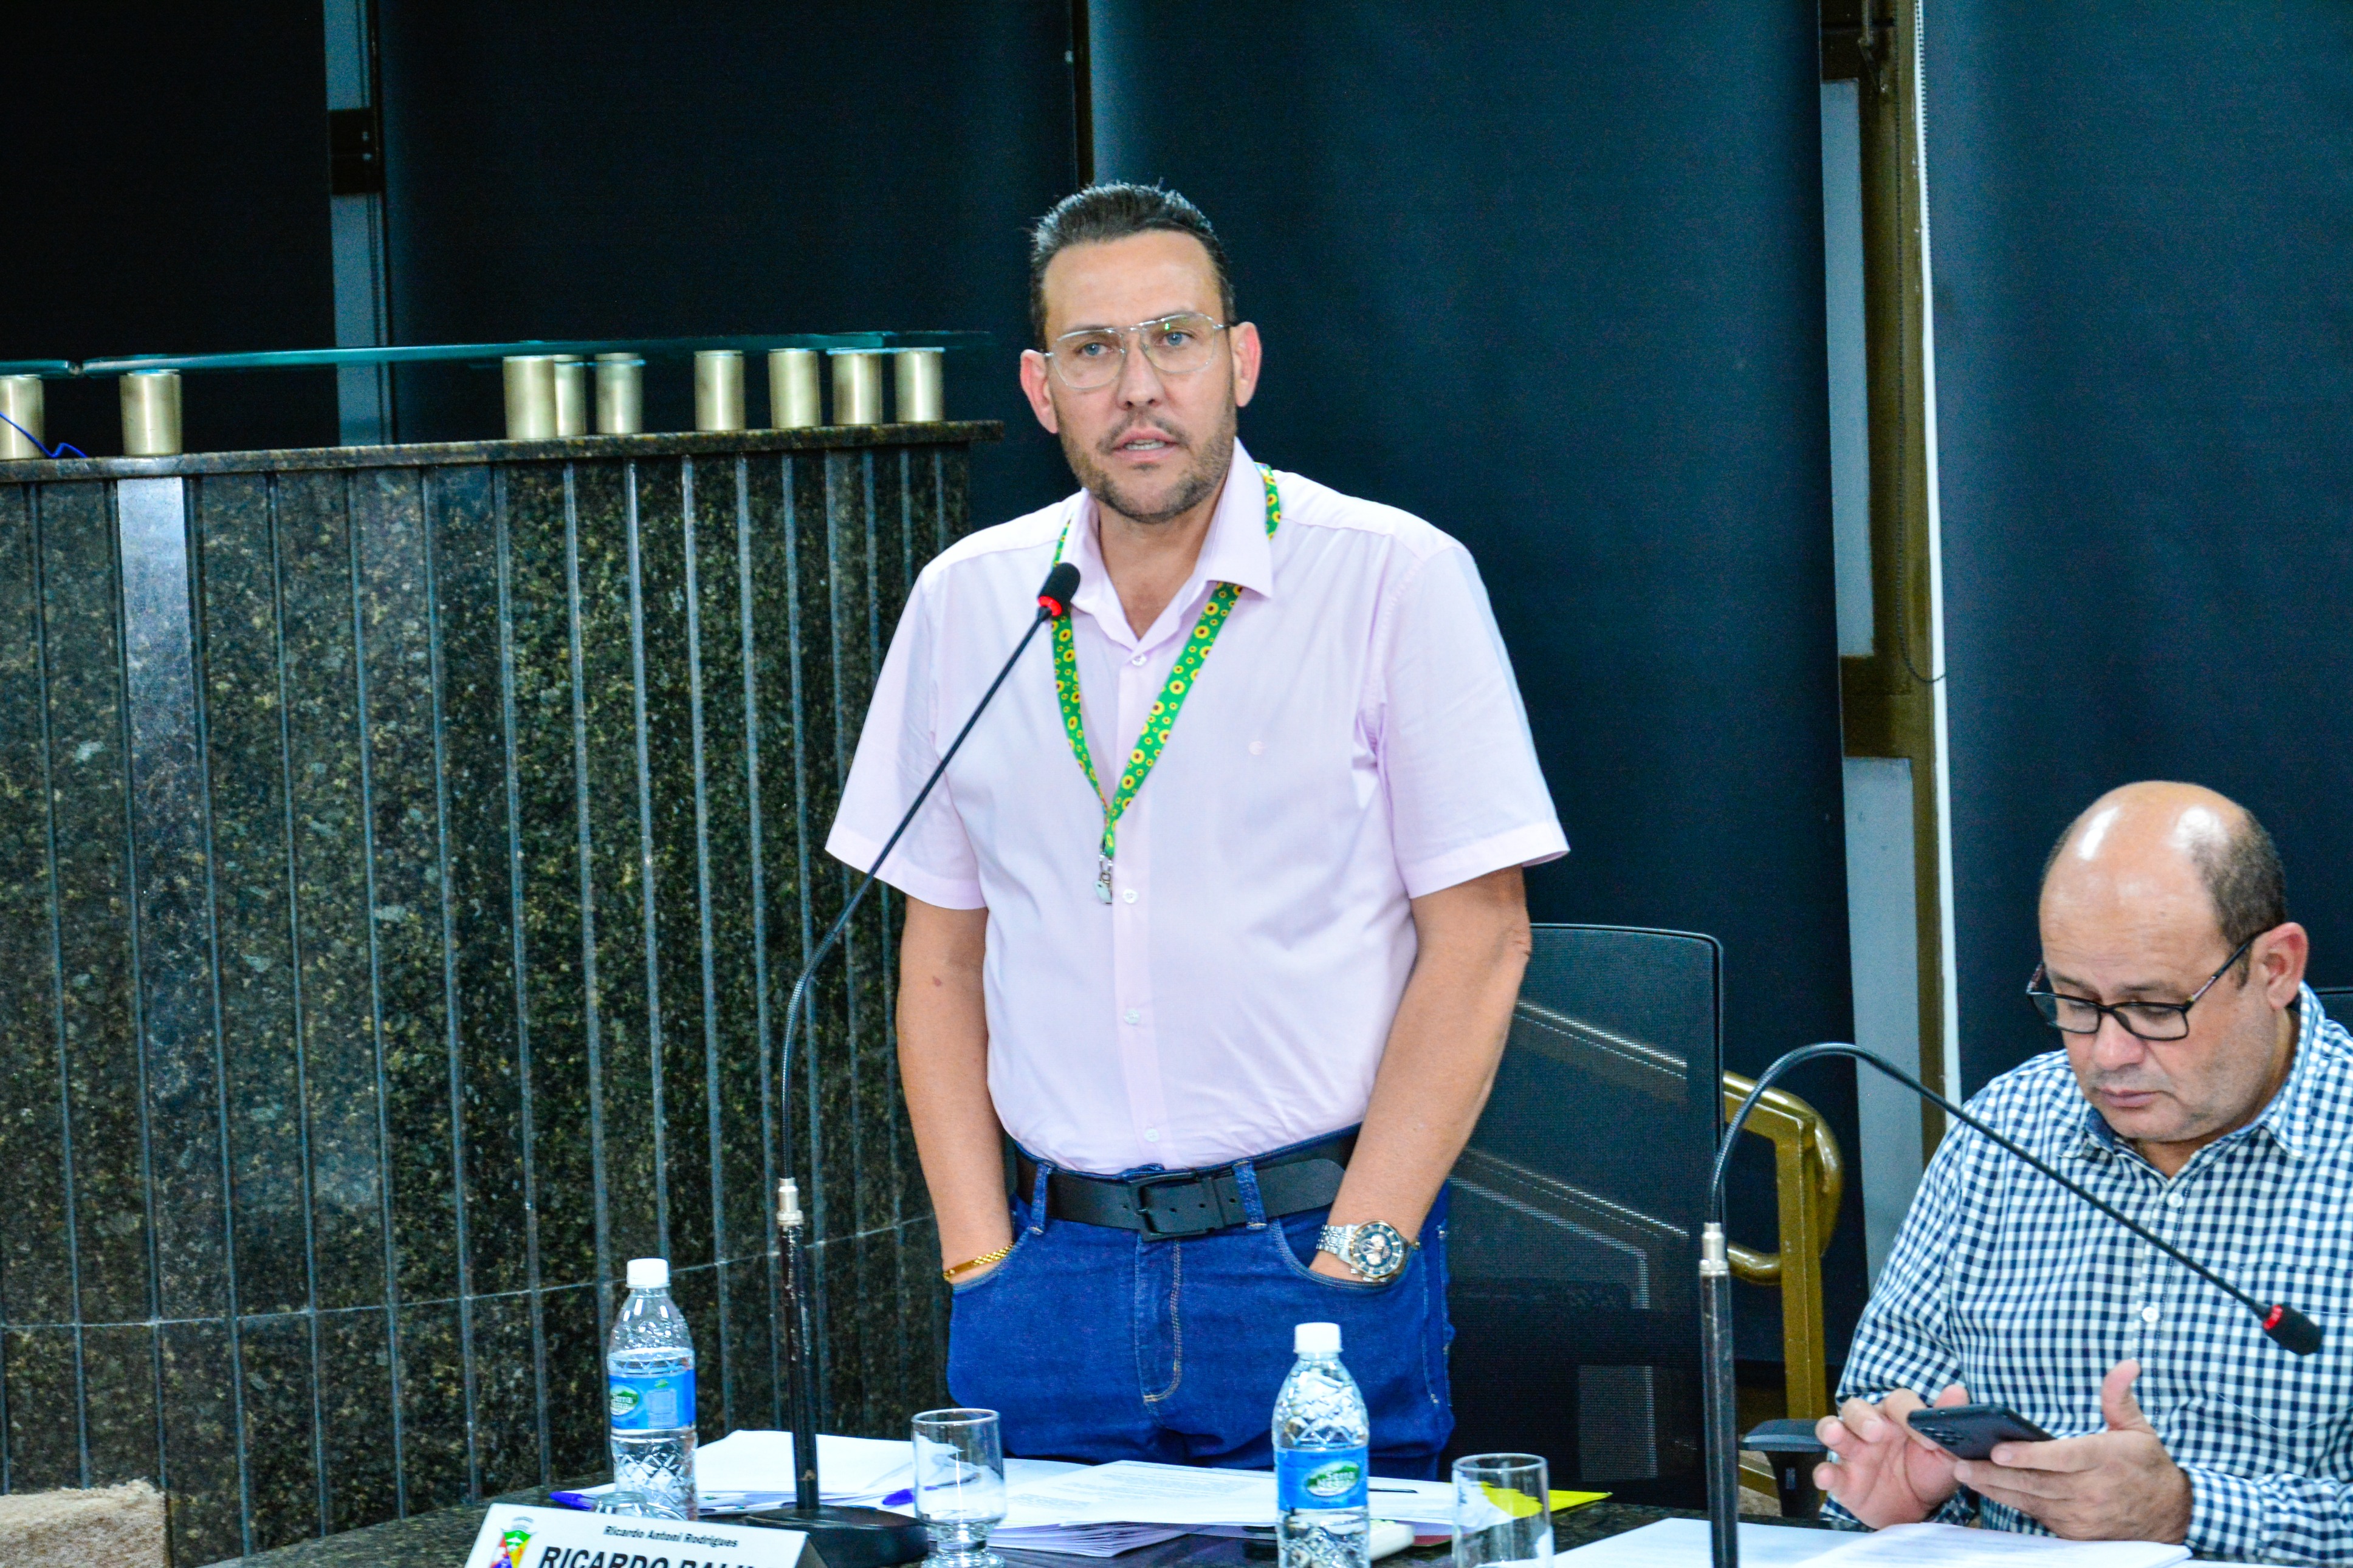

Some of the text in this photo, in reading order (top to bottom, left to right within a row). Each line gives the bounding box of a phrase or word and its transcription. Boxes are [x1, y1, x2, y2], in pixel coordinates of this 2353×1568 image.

[603, 1525, 739, 1547] Ricardo Antoni Rodrigues
